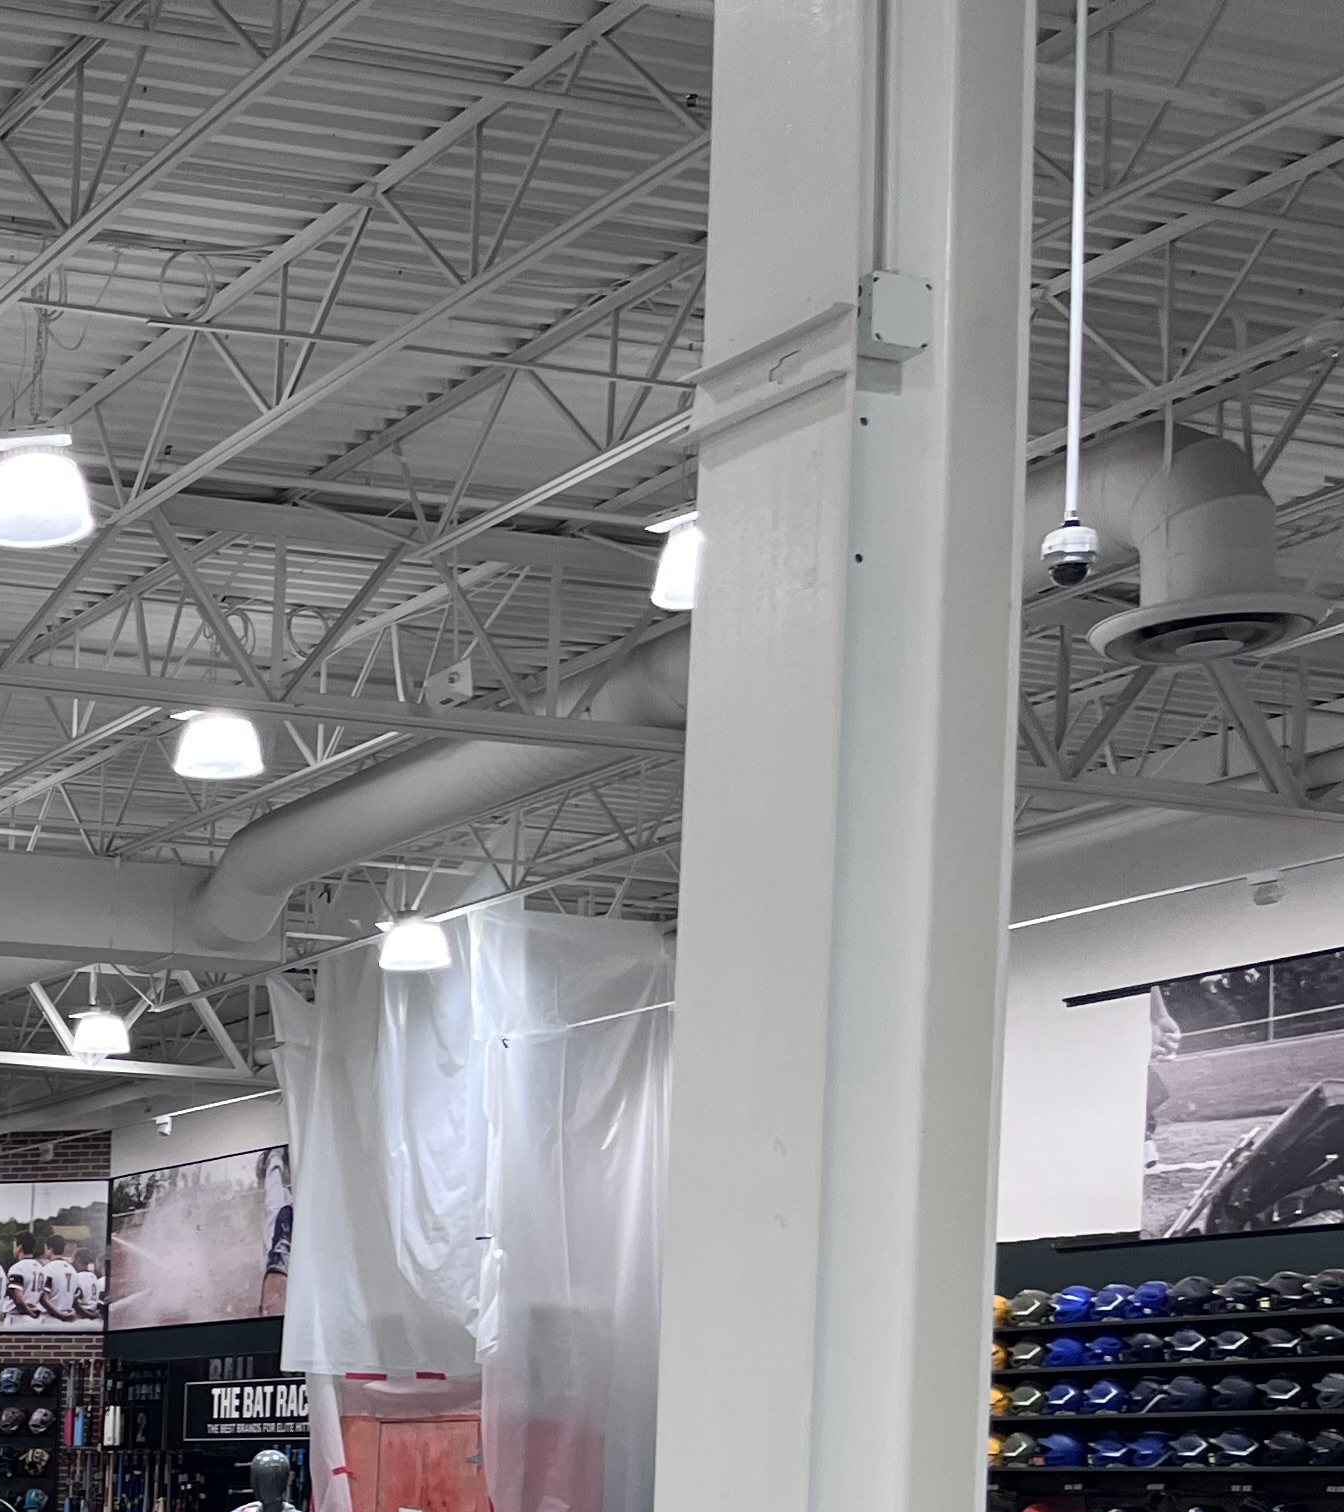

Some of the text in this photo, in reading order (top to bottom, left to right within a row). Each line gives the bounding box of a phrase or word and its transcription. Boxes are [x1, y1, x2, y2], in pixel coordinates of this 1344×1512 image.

[211, 1384, 309, 1419] THE BAT RAC
